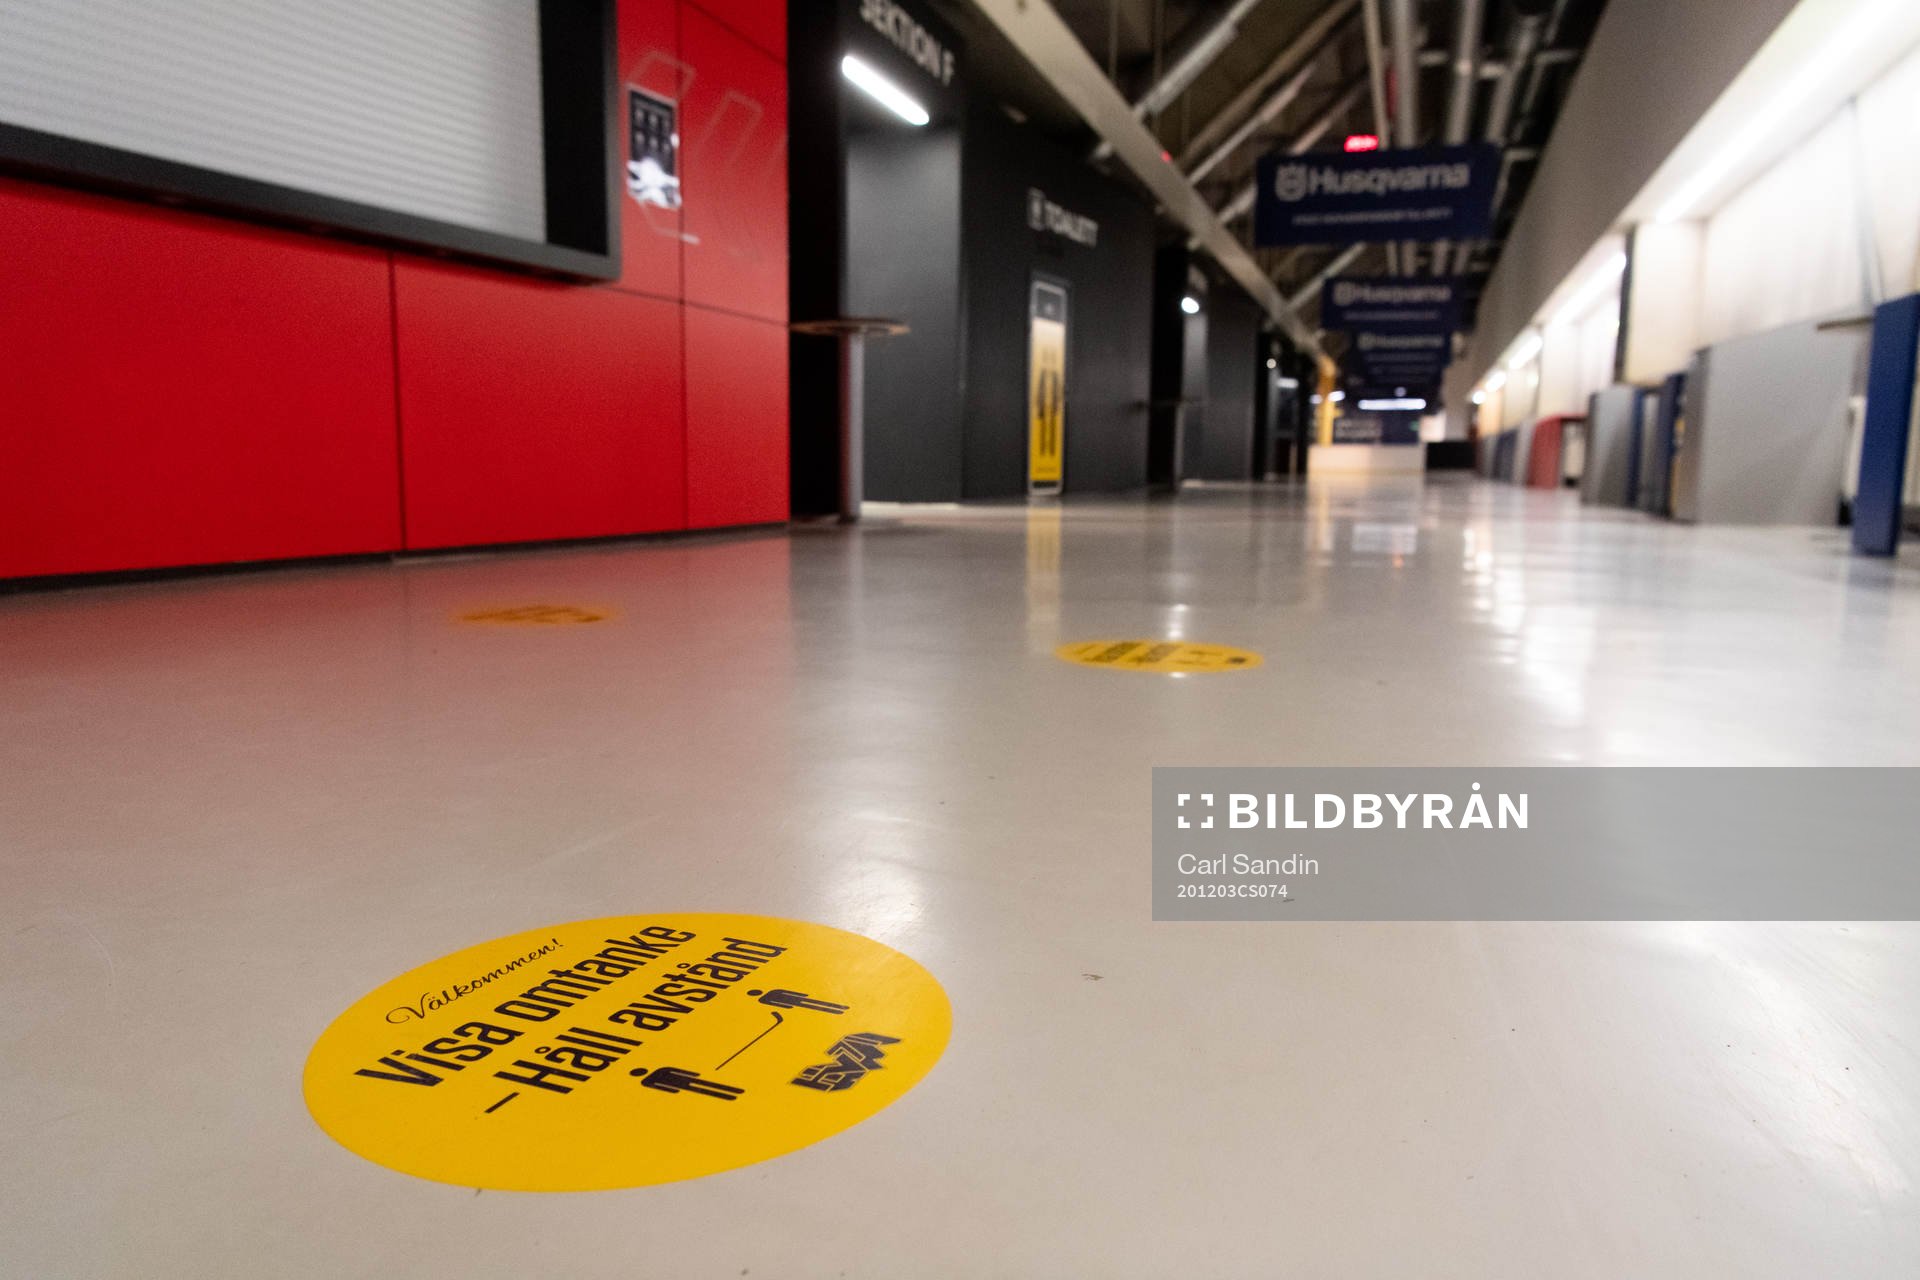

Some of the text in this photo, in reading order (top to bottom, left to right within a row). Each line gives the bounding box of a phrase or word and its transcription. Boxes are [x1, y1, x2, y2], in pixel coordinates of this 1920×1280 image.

[1308, 163, 1470, 197] Husqvarna
[354, 926, 697, 1087] Visa omtanke
[386, 938, 564, 1024] Välkommen!
[607, 937, 788, 1032] avstånd
